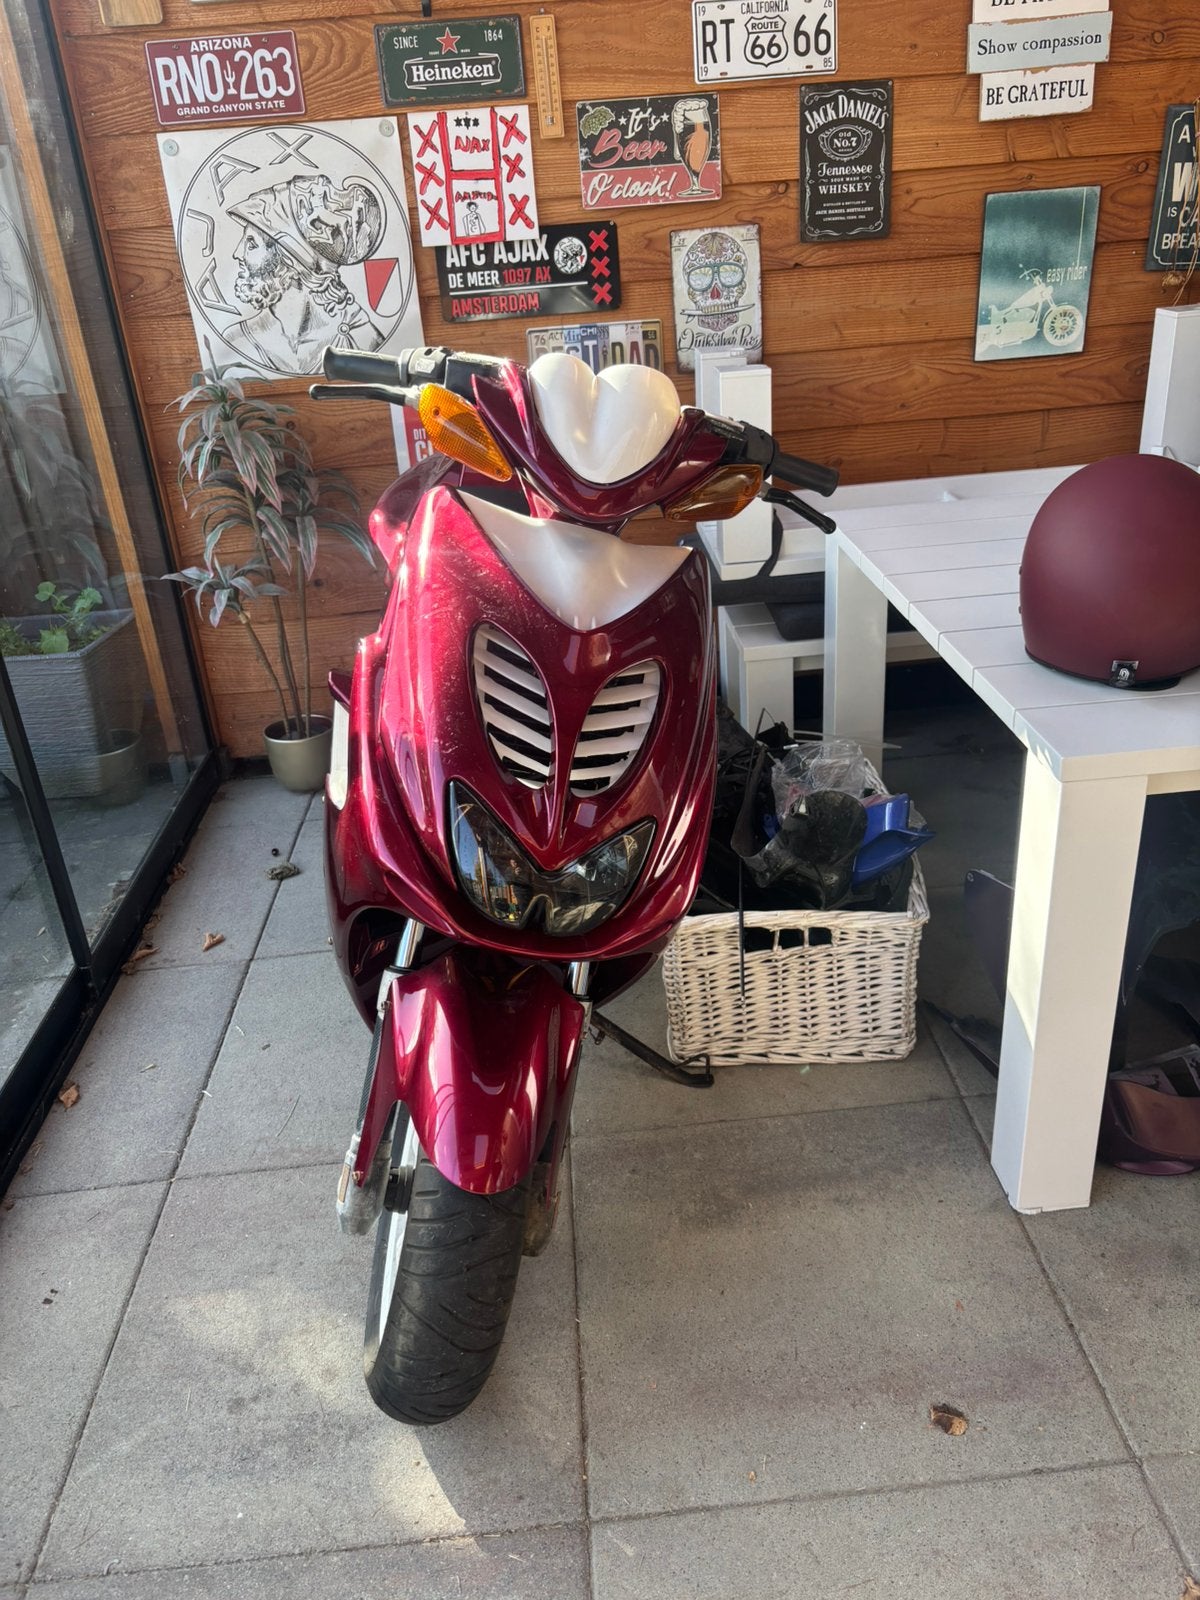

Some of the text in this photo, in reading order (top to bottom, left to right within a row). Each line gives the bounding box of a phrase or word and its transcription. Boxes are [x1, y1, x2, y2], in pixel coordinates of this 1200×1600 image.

[740, 0, 789, 15] CALIFORNIA
[751, 21, 779, 30] ROUTE
[190, 37, 252, 53] ARIZONA
[393, 29, 503, 49] SINCE 1864
[702, 12, 831, 64] RT 66
[750, 34, 782, 60] 66
[977, 30, 1102, 56] Show compassion
[154, 47, 296, 106] RNO 263
[410, 61, 495, 82] Heineken
[700, 57, 833, 77] 19 85
[986, 79, 1088, 106] BE GRATEFUL
[177, 100, 286, 116] GRAND CANYON STATE
[804, 94, 889, 134] JACK DANIEL'S
[624, 107, 661, 139] It's
[588, 128, 668, 168] Beer
[817, 162, 873, 177] Tennessee
[586, 171, 678, 206] O'clock!
[818, 182, 872, 195] WHISKEY
[1167, 206, 1178, 217] IS
[446, 234, 550, 268] AFC AJAX
[448, 265, 552, 289] DE MEER 1097 AX
[1046, 262, 1088, 286] easy rider
[452, 292, 540, 318] AMSTERDAM
